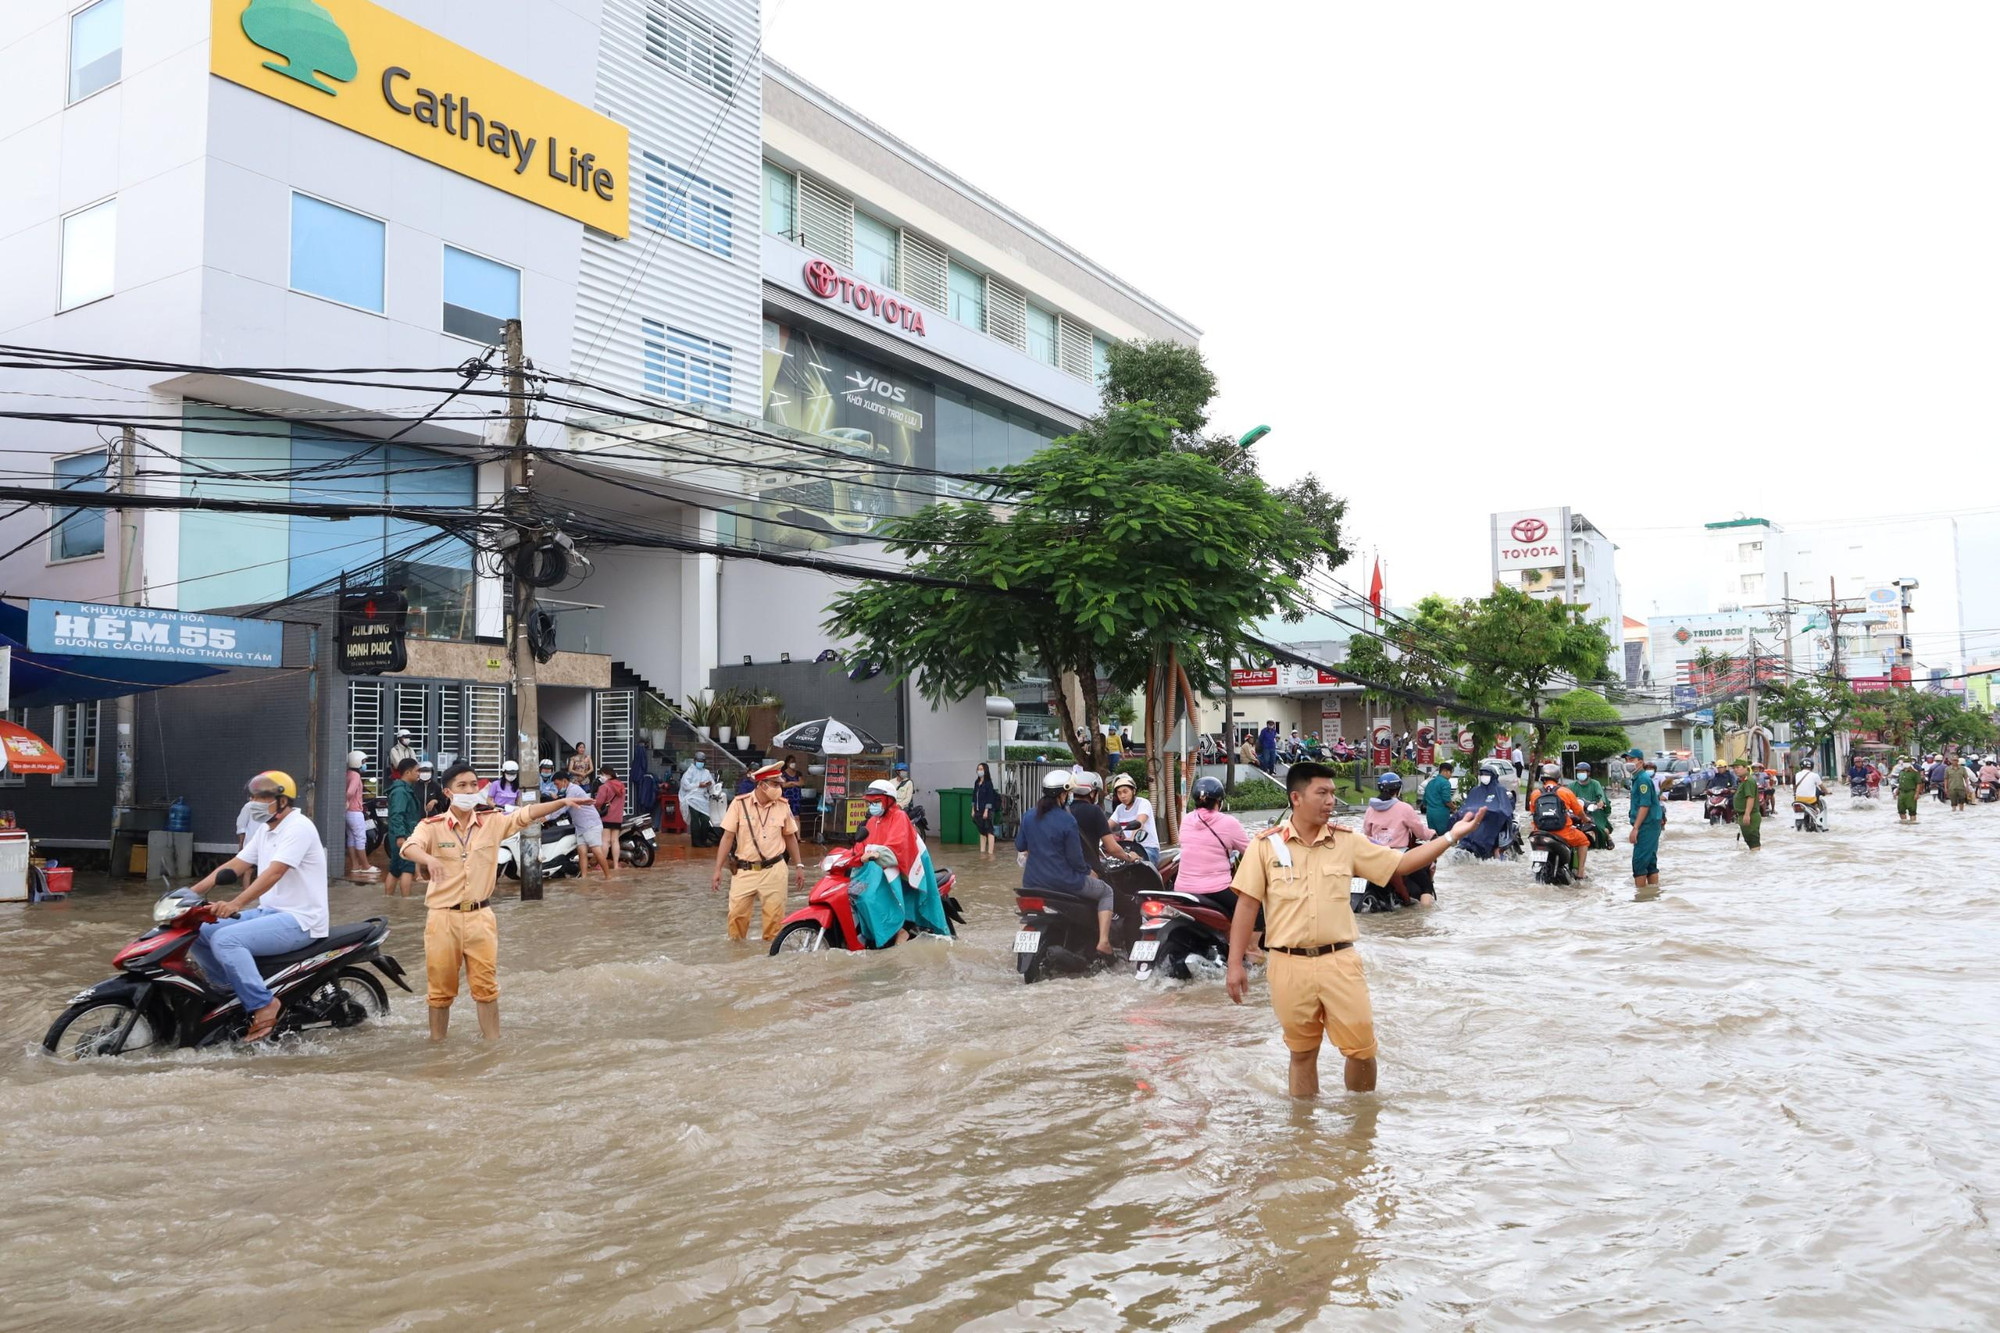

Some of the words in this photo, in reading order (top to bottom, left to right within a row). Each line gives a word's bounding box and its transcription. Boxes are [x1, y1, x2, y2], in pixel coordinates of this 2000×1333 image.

[381, 66, 537, 175] Cathay
[548, 136, 615, 201] Life
[839, 276, 926, 337] TOYOTA
[855, 370, 907, 403] VIOS
[1502, 546, 1559, 560] TOYOTA
[80, 605, 109, 615] KHU
[111, 607, 137, 618] VỰC
[139, 610, 146, 618] 2
[147, 611, 158, 619] P.
[160, 612, 177, 621] AN
[180, 625, 236, 650] 55
[1693, 629, 1723, 637] TRUNG
[55, 637, 109, 649] ĐƯỜNG
[113, 641, 153, 653] CÁCH
[155, 645, 196, 656] MẠNG
[198, 649, 243, 660] THÁNG
[246, 652, 272, 662] TÁM
[346, 642, 369, 661] HẠNH
[370, 638, 393, 656] PHÚC
